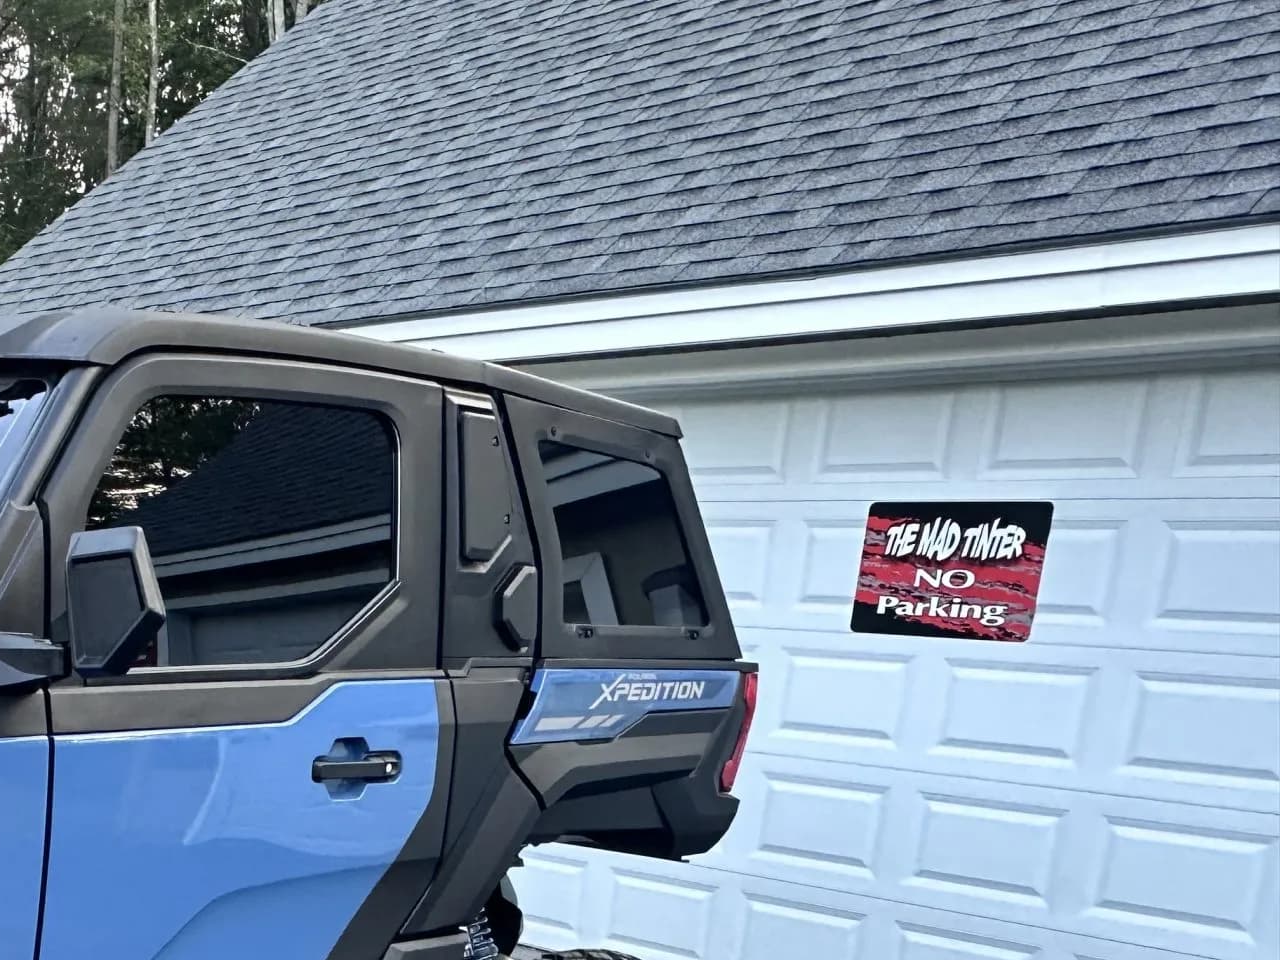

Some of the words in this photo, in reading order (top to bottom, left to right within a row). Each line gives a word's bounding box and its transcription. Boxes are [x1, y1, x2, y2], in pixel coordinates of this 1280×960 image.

[884, 522, 920, 558] THE
[916, 516, 962, 561] MAD
[961, 517, 1027, 561] TINTER
[914, 568, 976, 589] NO
[876, 595, 1009, 627] Parking
[588, 673, 706, 710] XPEDITION
